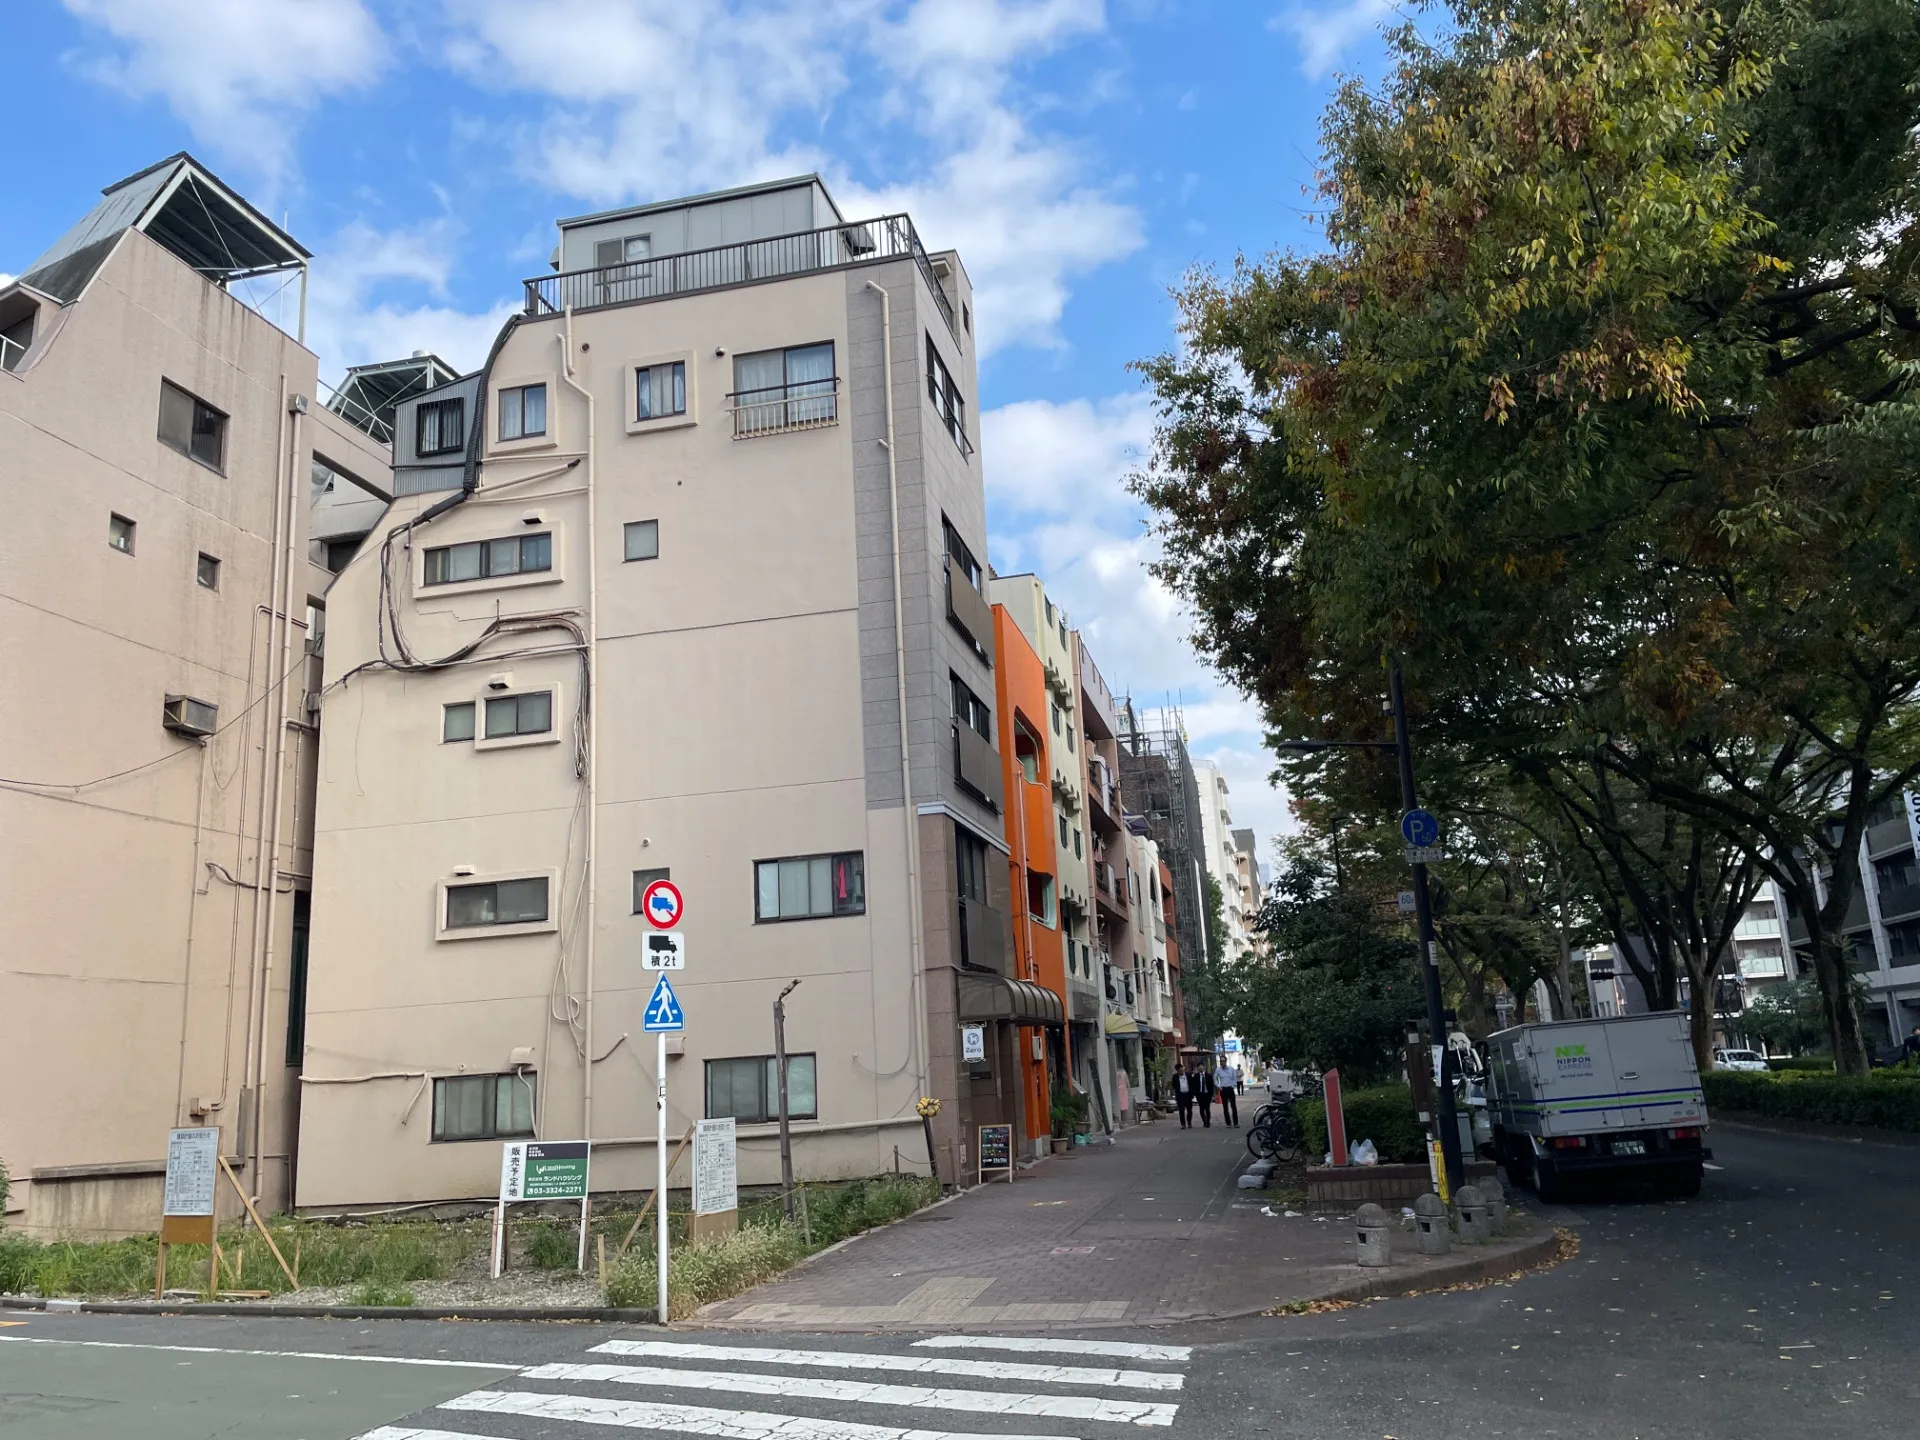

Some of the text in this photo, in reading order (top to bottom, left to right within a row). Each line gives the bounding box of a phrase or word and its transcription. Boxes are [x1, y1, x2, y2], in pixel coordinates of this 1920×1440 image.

[1410, 820, 1423, 843] P
[1556, 1056, 1591, 1065] NIPPON
[508, 1146, 521, 1197] 販売予定地
[543, 1174, 582, 1182] ランドハウジング
[534, 1186, 582, 1195] 03-3324-2271
